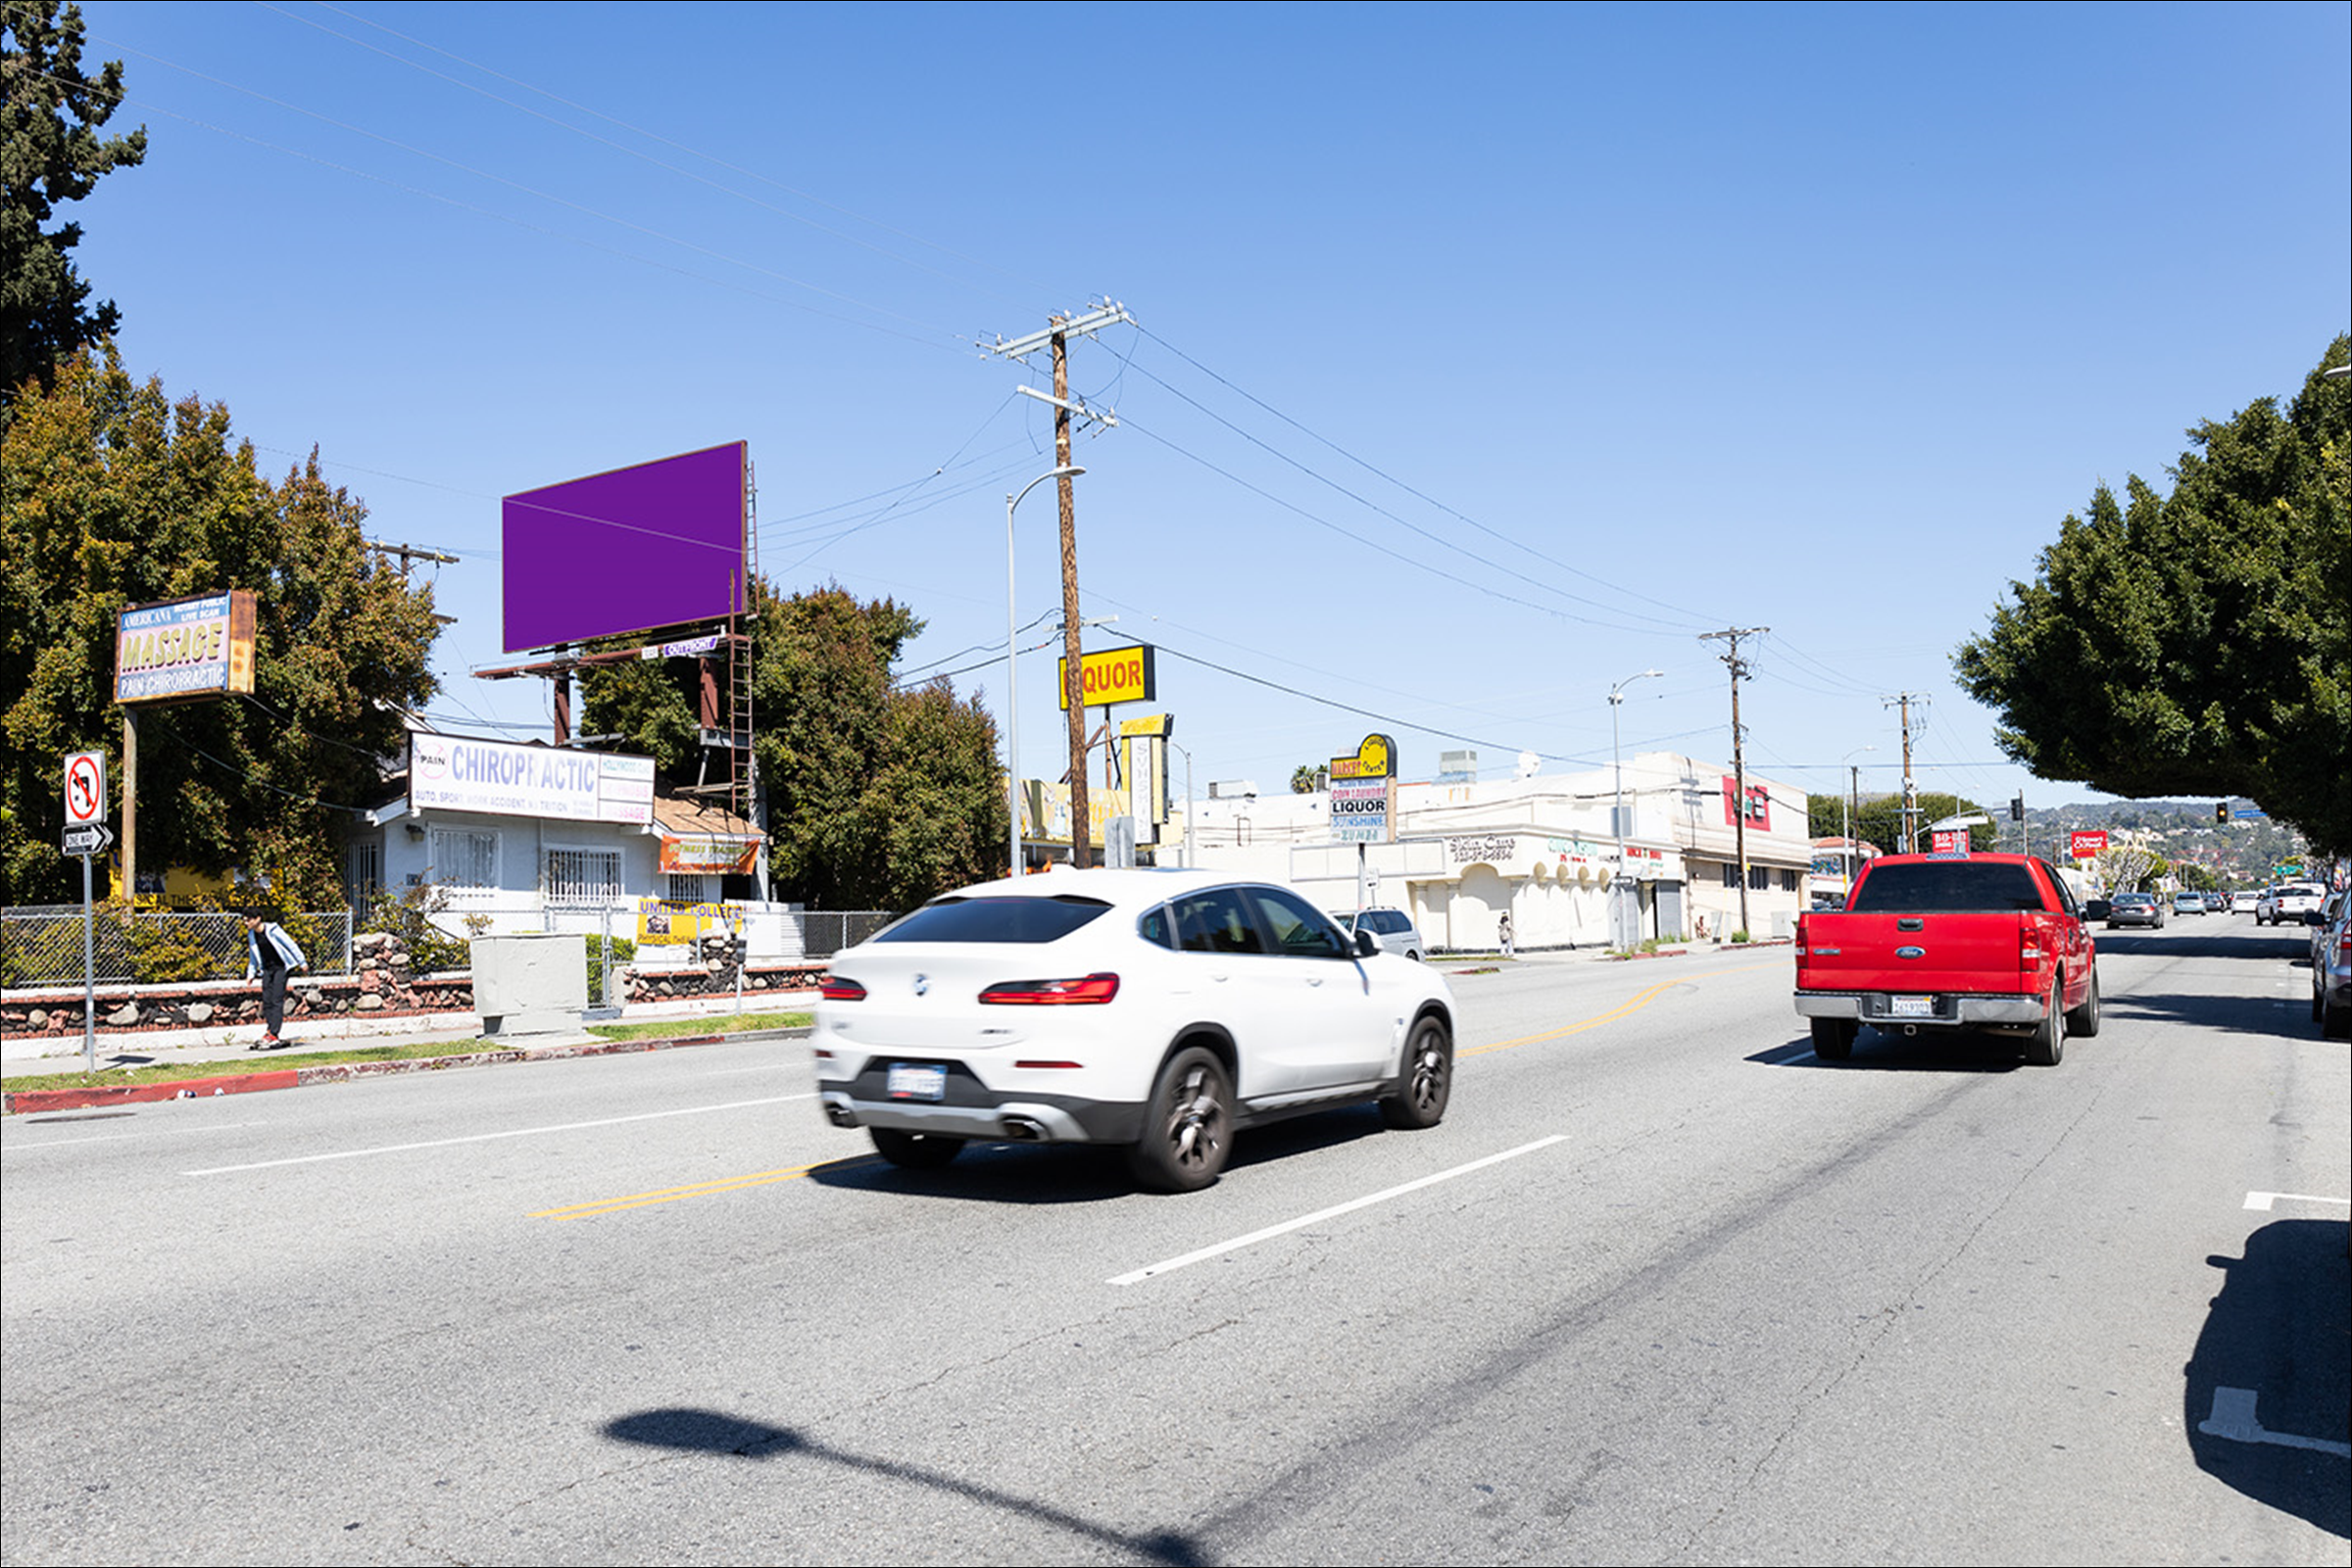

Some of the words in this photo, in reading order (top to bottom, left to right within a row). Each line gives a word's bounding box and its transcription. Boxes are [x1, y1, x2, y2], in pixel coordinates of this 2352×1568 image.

[201, 597, 227, 609] PUBLIC
[124, 610, 172, 627] AMERICANA
[181, 612, 196, 621] LIVE
[200, 609, 220, 618] SCAN
[122, 622, 223, 671] MASSAGE
[121, 676, 145, 696] PAIN
[147, 666, 224, 691] CHIROPRACTIC
[1063, 661, 1142, 695] QUOR
[420, 755, 446, 765] PAIN
[1332, 760, 1361, 775] MARKET
[1332, 788, 1349, 800] COIN
[1351, 787, 1386, 799] LAUNDRY
[606, 804, 645, 819] SSAGE
[1333, 800, 1385, 812] LIQUOR
[1333, 815, 1384, 827] SUNSHINE
[67, 834, 79, 846] ONE
[80, 833, 93, 844] WAY
[640, 901, 685, 914] UNITED
